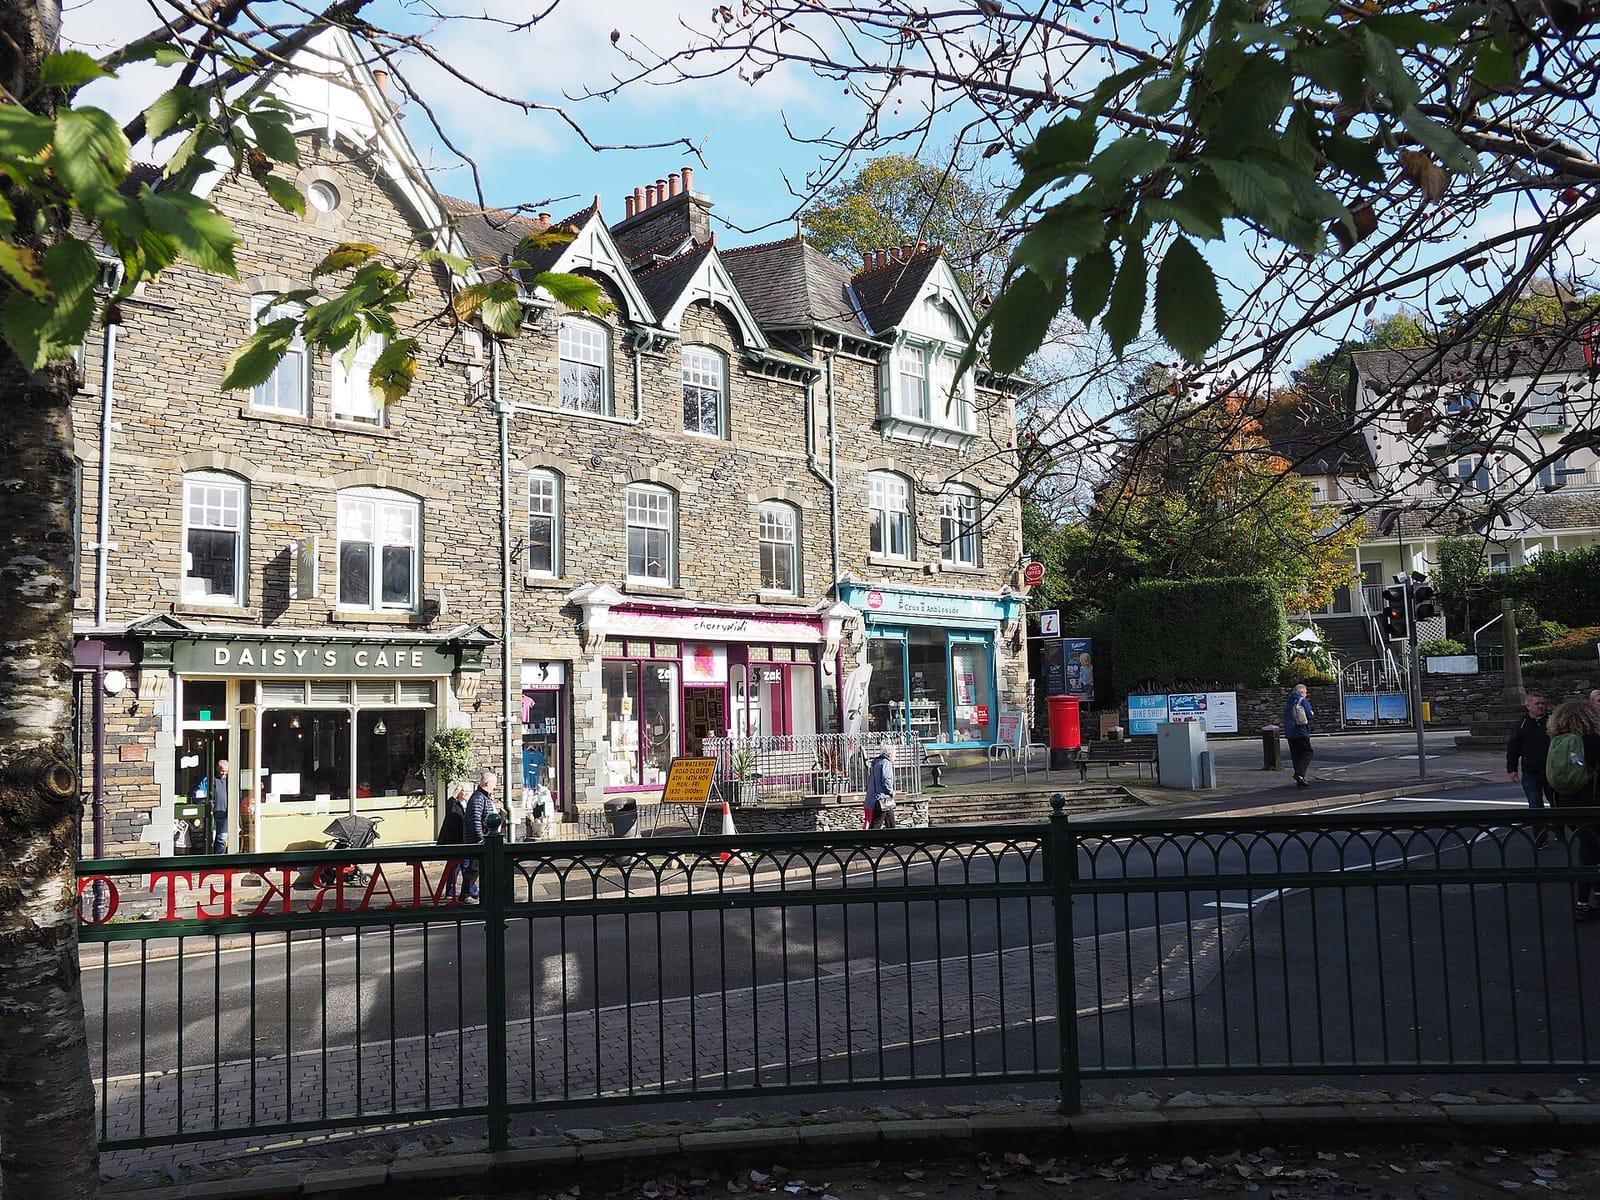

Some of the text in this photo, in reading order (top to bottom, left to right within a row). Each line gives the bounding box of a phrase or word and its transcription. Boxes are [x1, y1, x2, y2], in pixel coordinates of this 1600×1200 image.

[926, 604, 960, 614] Ambleside
[214, 647, 423, 667] DAISY'S CAFE
[763, 669, 781, 680] zak
[1132, 708, 1163, 718] BIKE SHOP
